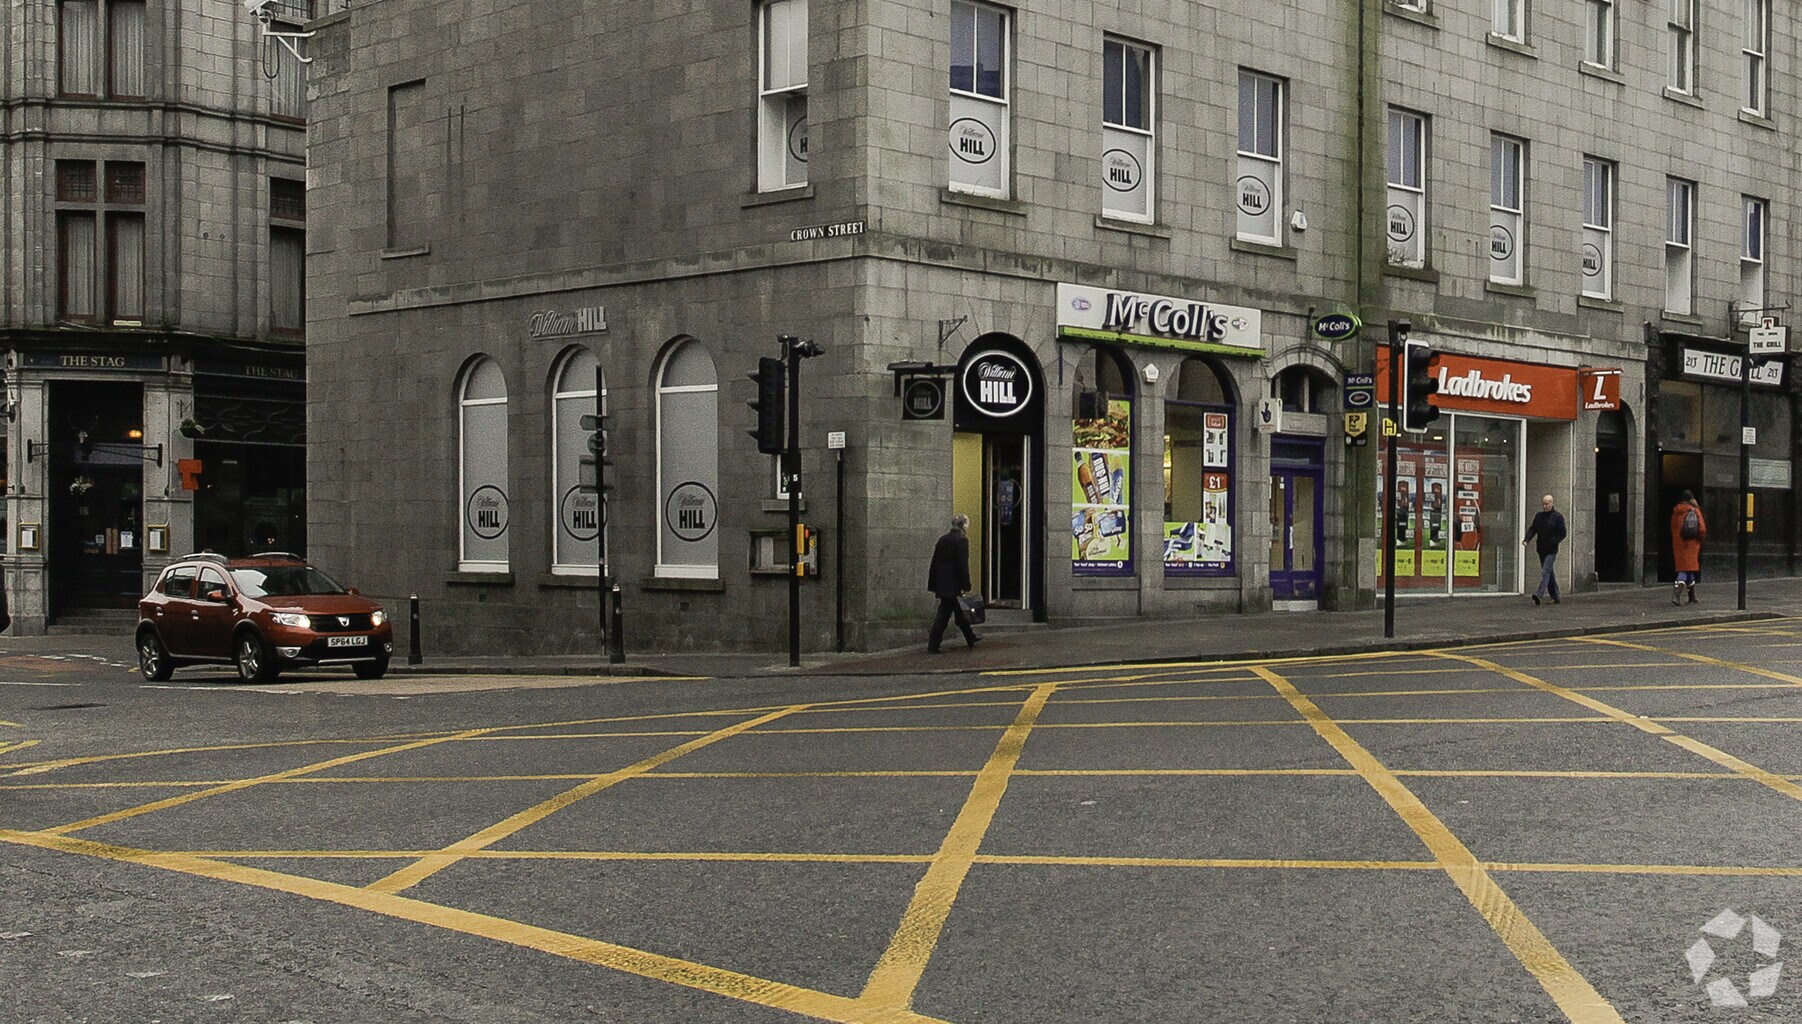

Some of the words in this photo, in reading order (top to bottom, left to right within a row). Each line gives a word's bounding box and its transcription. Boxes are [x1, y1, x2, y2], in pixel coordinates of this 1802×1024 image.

[960, 137, 985, 156] HILL
[1110, 167, 1132, 184] HILL
[1243, 192, 1262, 208] HILL
[790, 226, 825, 241] CROWN
[828, 221, 864, 237] STREET
[1391, 221, 1407, 235] HILL
[527, 310, 577, 337] William
[577, 306, 607, 331] HILL
[1104, 293, 1229, 341] McColl's
[1763, 319, 1772, 330] T
[60, 356, 87, 366] THE
[91, 356, 125, 367] STAG
[1685, 357, 1698, 368] 213
[1703, 355, 1727, 375] THE
[1730, 359, 1762, 380] GLL
[1768, 367, 1779, 379] 213
[246, 366, 267, 376] THE
[977, 362, 1017, 380] William
[980, 380, 1017, 404] HILL
[1437, 366, 1532, 403] Ladbrokes
[1593, 376, 1607, 400] L
[913, 397, 933, 410] HILL
[1584, 401, 1615, 409] Ladbrokes
[1208, 476, 1221, 490] £1
[478, 510, 500, 528] HILL
[573, 511, 597, 529] HILL
[679, 509, 706, 529] HILL
[331, 637, 350, 646] SP64
